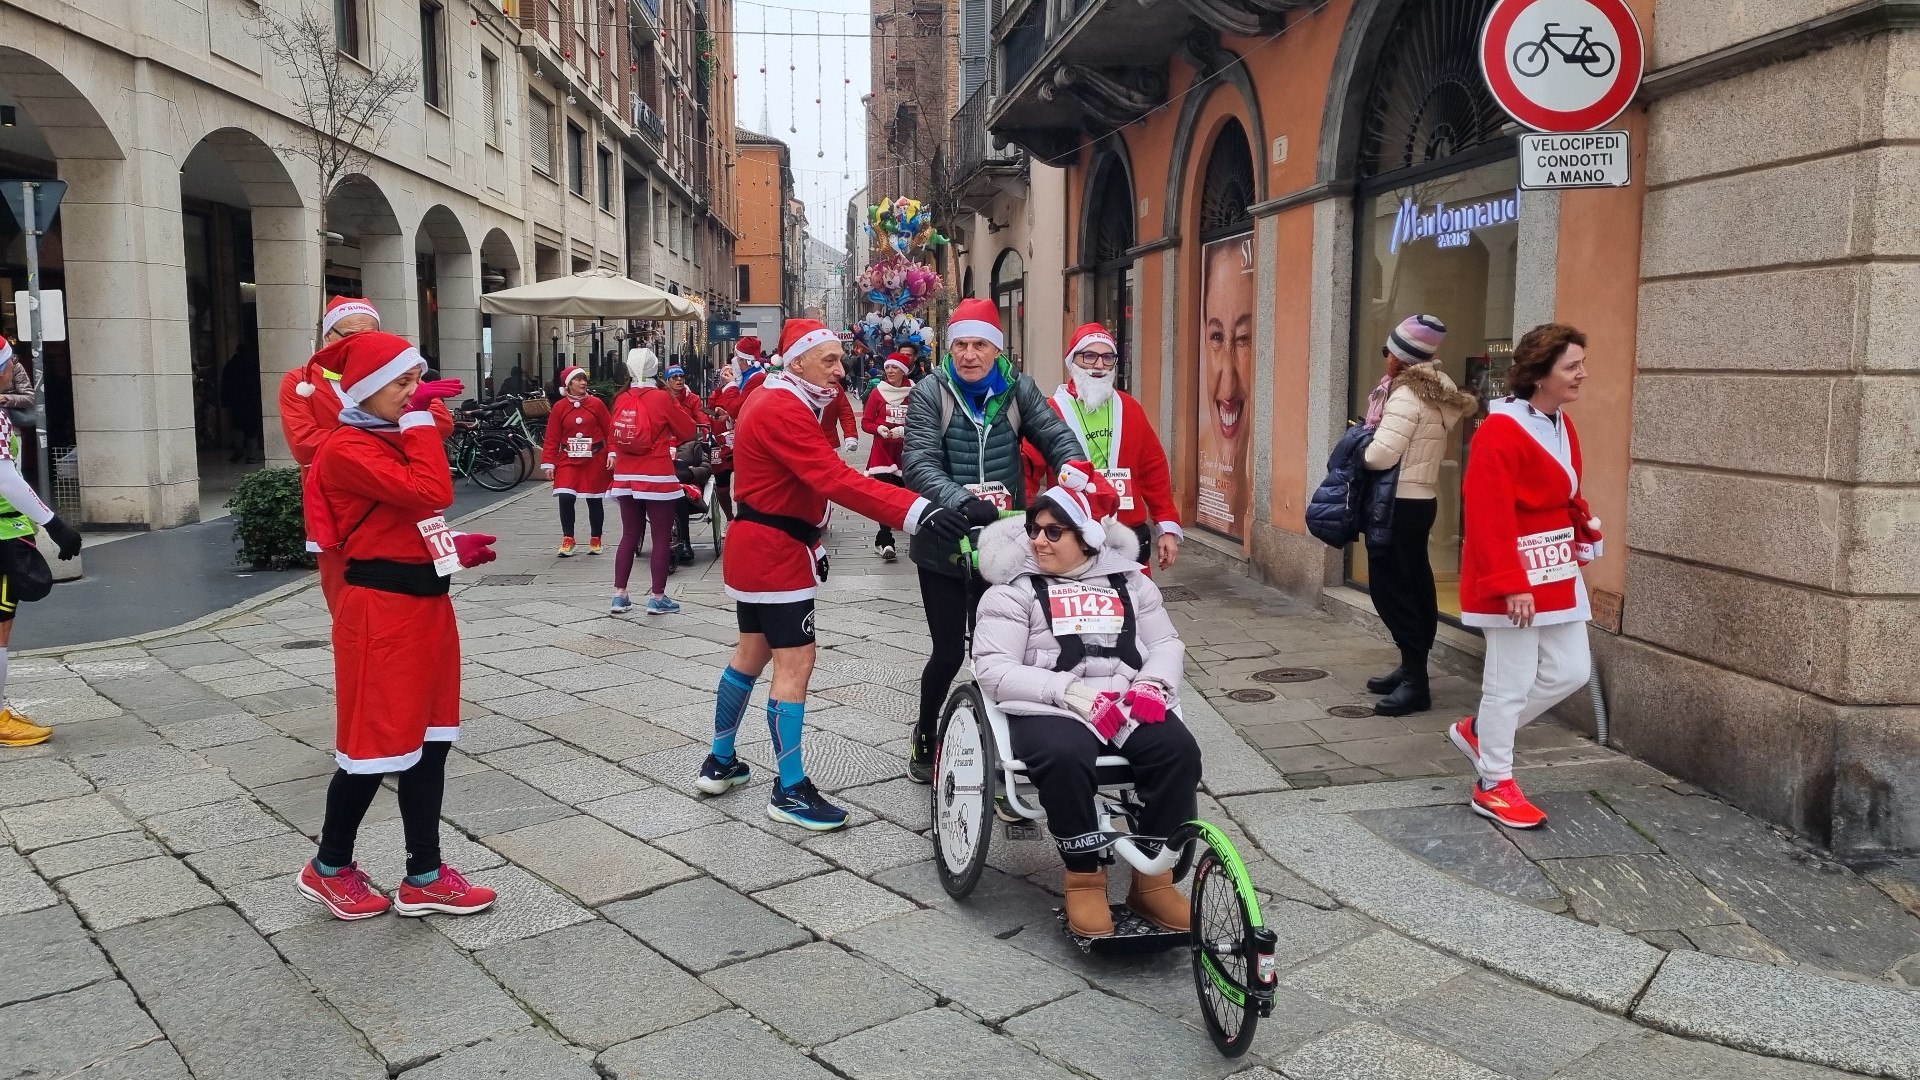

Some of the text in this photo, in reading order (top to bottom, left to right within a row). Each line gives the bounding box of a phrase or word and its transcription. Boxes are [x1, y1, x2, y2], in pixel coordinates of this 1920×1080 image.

[1531, 136, 1619, 151] VELOCIPEDI
[1537, 153, 1613, 168] CONDOTTI
[1546, 169, 1605, 183] A MANO
[1390, 184, 1521, 254] Marionnaud
[1437, 229, 1471, 248] PARIS
[569, 443, 588, 451] 1139
[981, 485, 1004, 493] RUNNIN
[422, 520, 444, 534] BABBO
[430, 531, 457, 557] 10
[1518, 532, 1572, 548] BABBO RUNNING
[1525, 543, 1572, 569] 1190
[1051, 585, 1114, 596] BABBO RUNNING
[1060, 594, 1115, 617] 1142
[1063, 833, 1107, 851] PLANETA
